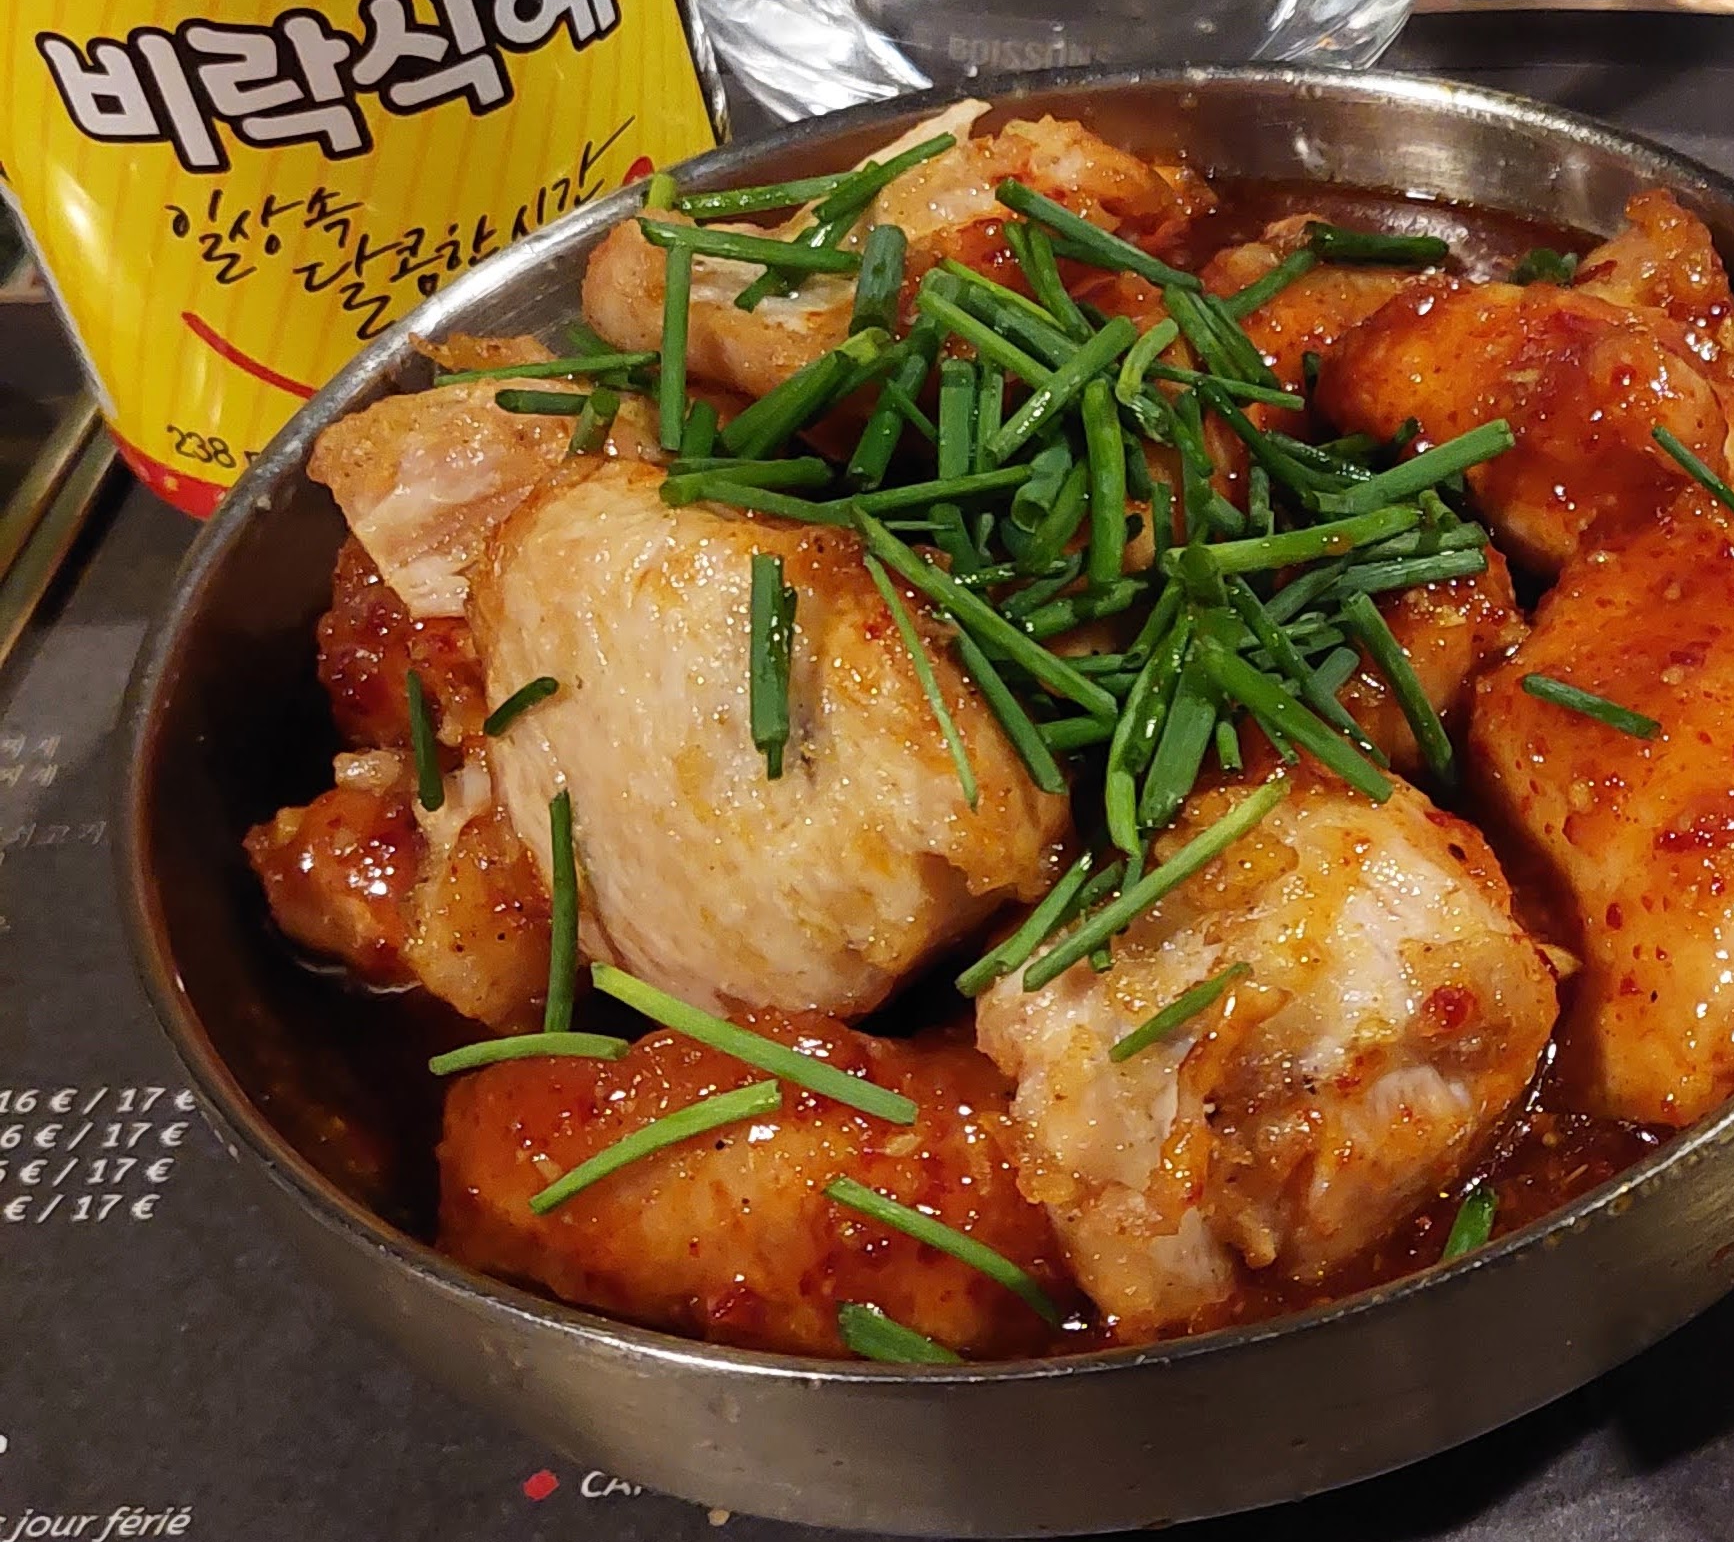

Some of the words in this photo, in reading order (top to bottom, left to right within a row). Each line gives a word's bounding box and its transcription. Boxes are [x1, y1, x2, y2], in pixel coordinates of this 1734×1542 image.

[167, 424, 237, 468] 238
[50, 1088, 78, 1113] €
[117, 1087, 166, 1112] 17
[34, 1123, 63, 1148] €
[101, 1122, 152, 1148] 17
[159, 1122, 189, 1146] €
[19, 1159, 48, 1185] €
[87, 1158, 138, 1184] 17
[146, 1158, 174, 1183] €
[4, 1196, 33, 1222] €
[71, 1194, 124, 1221] 17
[131, 1194, 161, 1220] €
